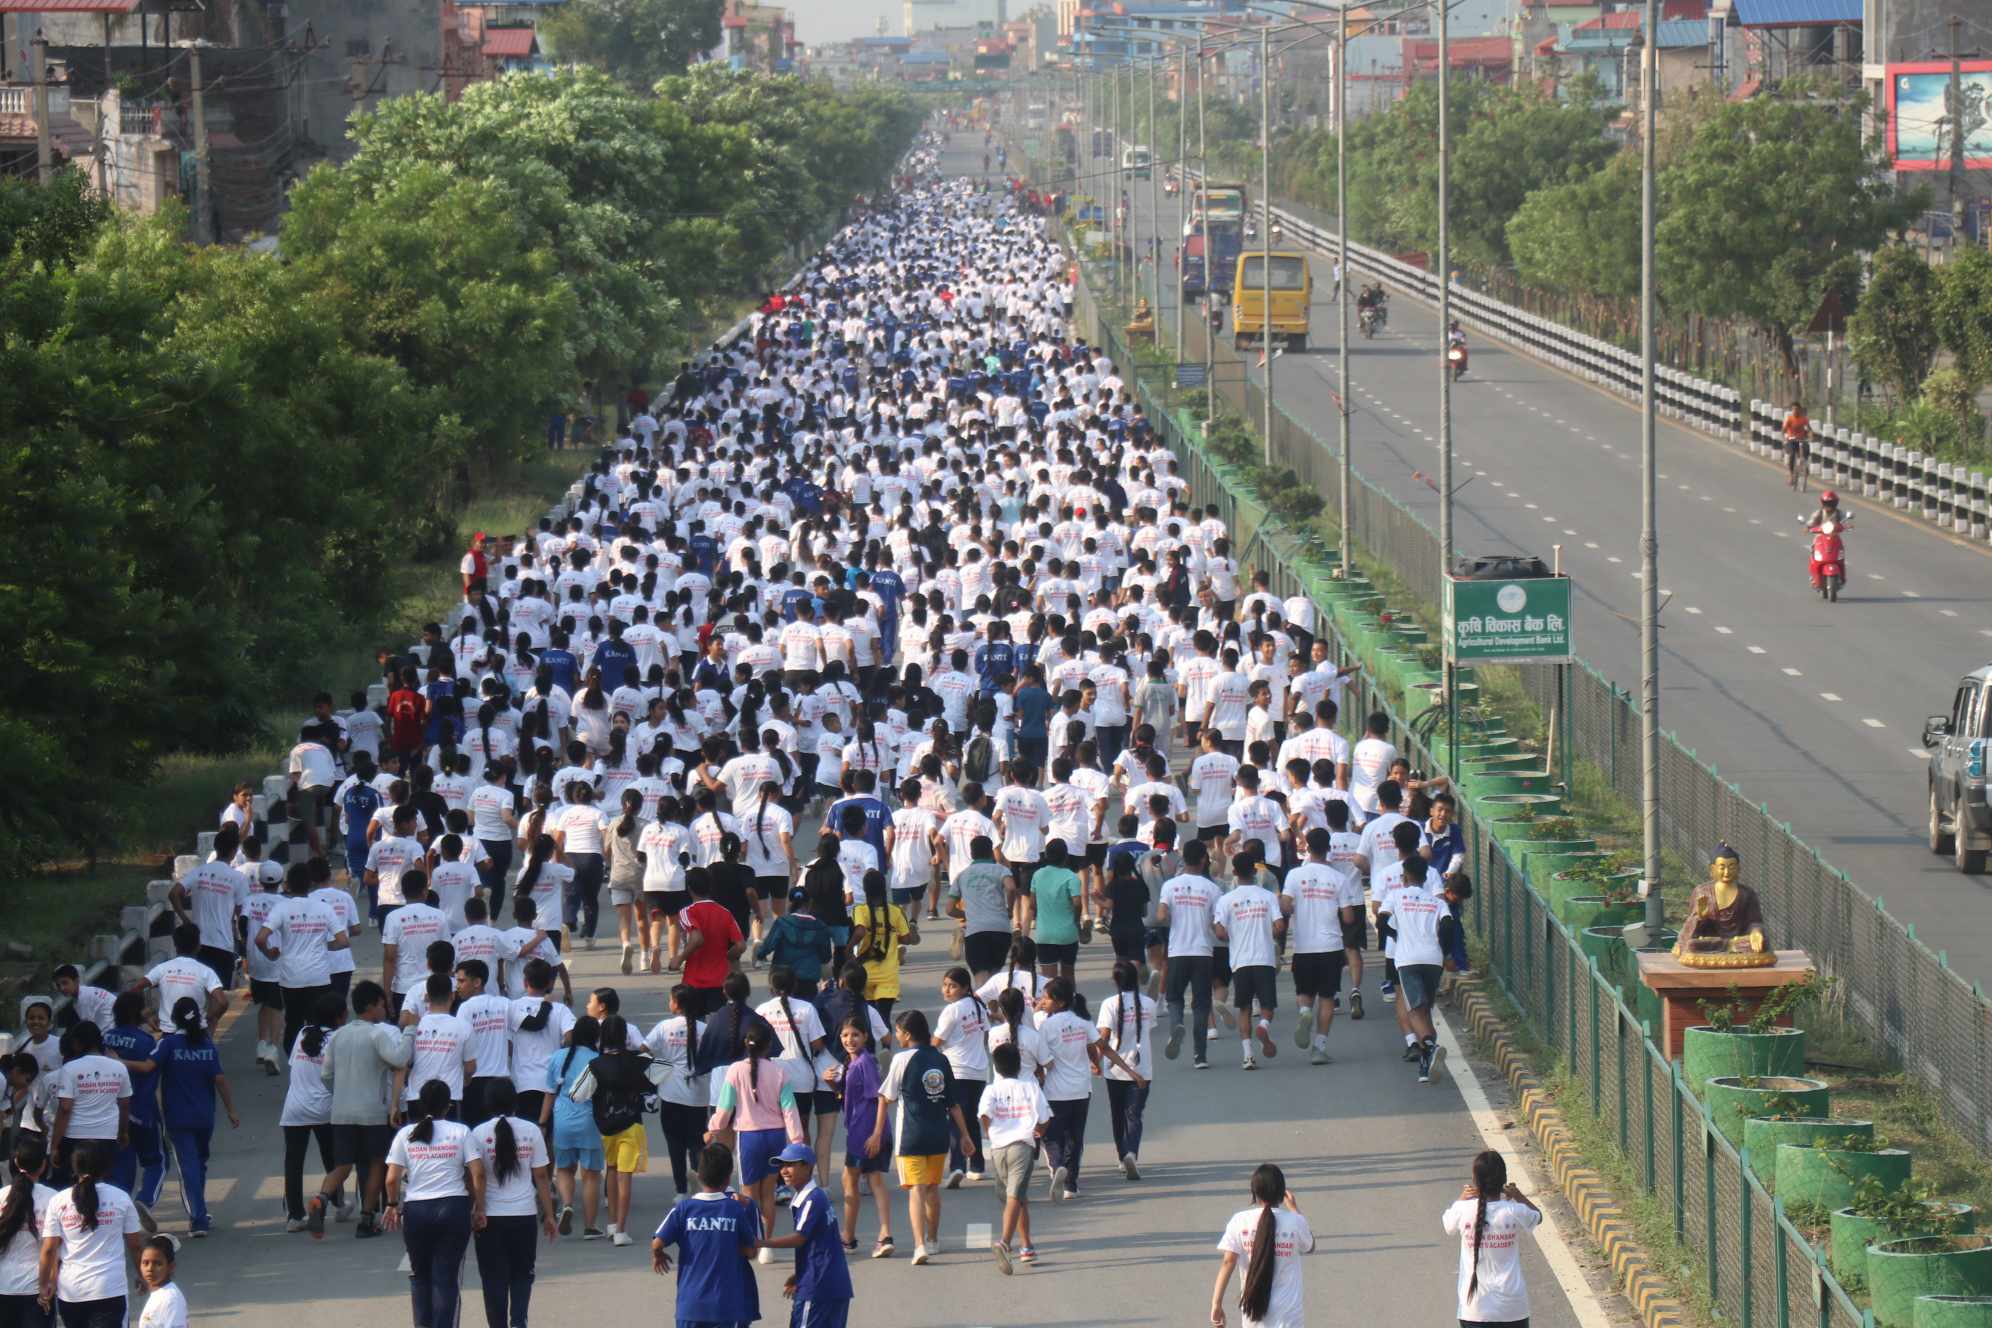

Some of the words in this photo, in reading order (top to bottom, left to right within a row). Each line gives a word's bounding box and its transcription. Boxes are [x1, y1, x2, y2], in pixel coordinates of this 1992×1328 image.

[1485, 615, 1521, 633] विकास
[173, 1049, 214, 1062] KANTI
[686, 1217, 737, 1232] KANTI
